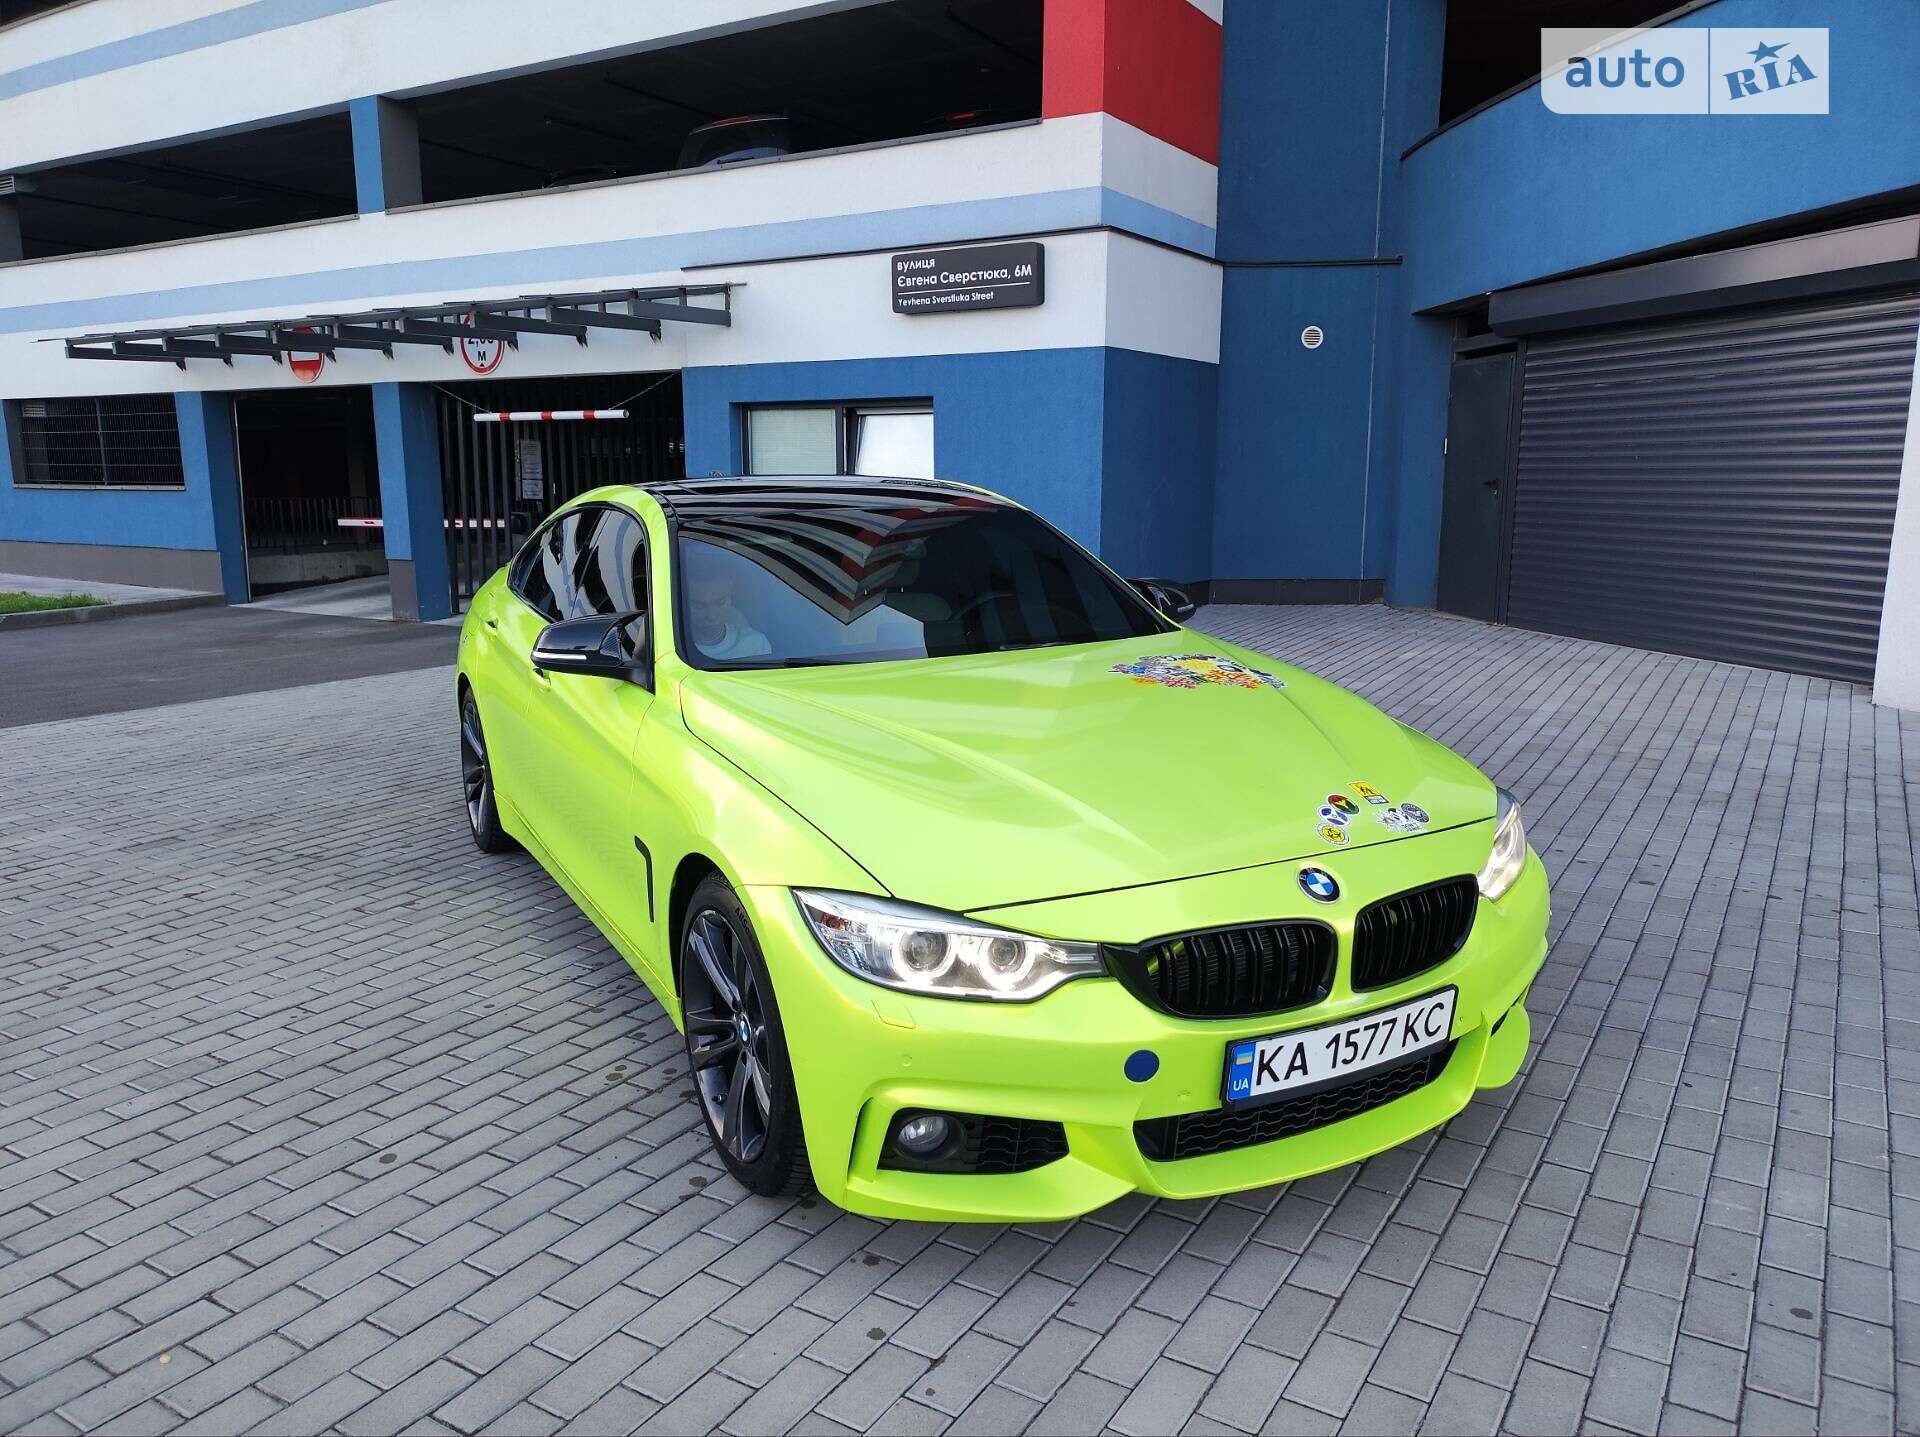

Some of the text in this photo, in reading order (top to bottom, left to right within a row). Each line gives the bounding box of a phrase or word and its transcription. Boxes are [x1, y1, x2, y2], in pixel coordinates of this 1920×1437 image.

[897, 258, 935, 273] вулиця
[897, 264, 1032, 287] Євгена Сверстюка, 6М
[898, 297, 931, 307] Yevhena
[971, 291, 994, 301] Street
[1256, 1002, 1445, 1086] KA 1577 KC
[1233, 1077, 1249, 1092] UA
